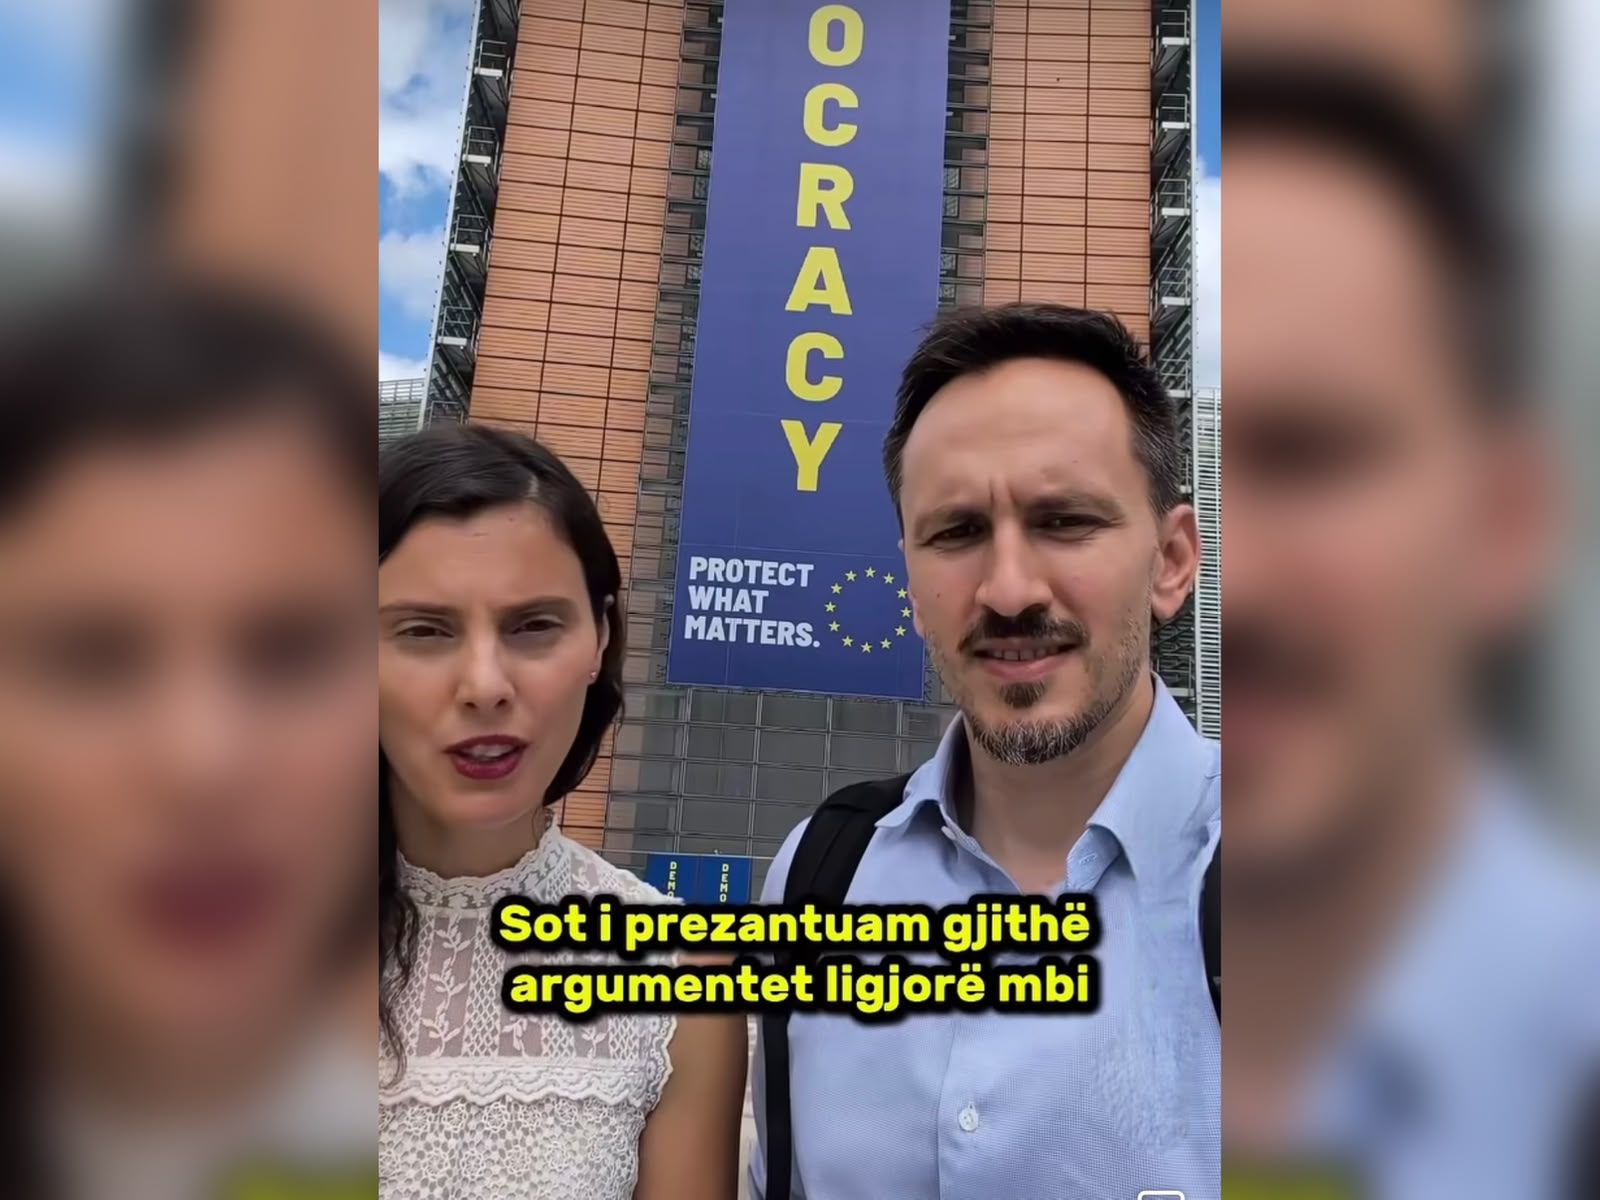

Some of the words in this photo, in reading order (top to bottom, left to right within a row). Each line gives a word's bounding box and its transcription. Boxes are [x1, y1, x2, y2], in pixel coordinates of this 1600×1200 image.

[689, 556, 814, 587] PROTECT
[688, 585, 769, 614] WHAT
[684, 615, 820, 648] MATTERS.
[719, 863, 730, 903] DEMO
